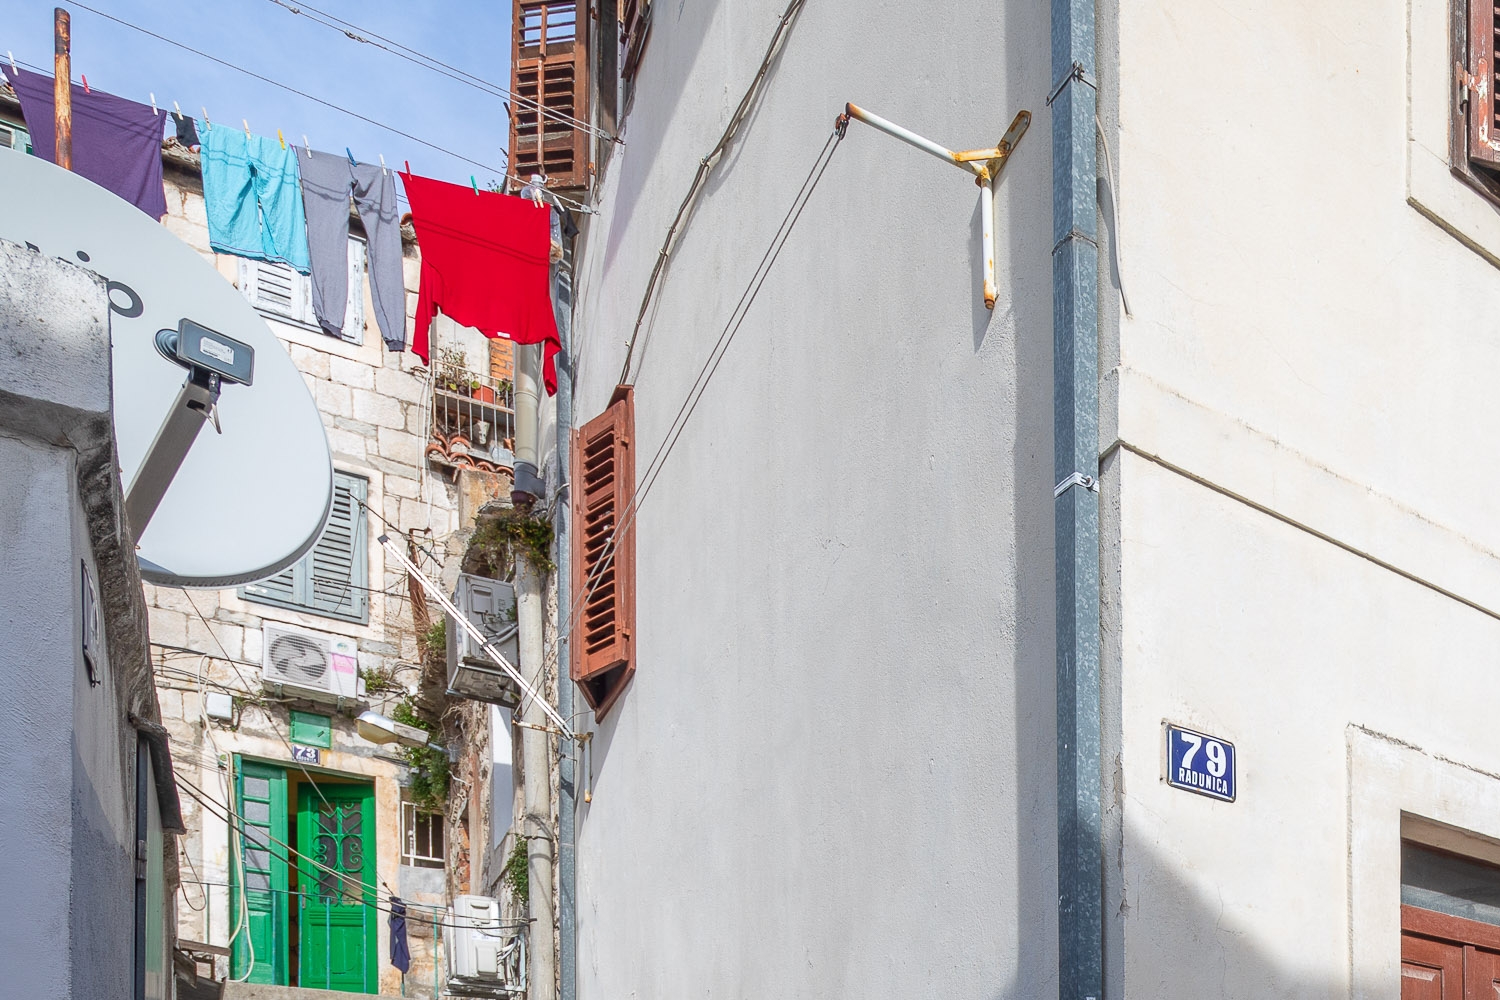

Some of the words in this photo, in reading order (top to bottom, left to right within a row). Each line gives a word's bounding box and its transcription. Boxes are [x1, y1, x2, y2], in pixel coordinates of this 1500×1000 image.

[295, 745, 316, 759] 73
[1180, 731, 1227, 778] 79
[1179, 767, 1228, 795] RADUNICA
